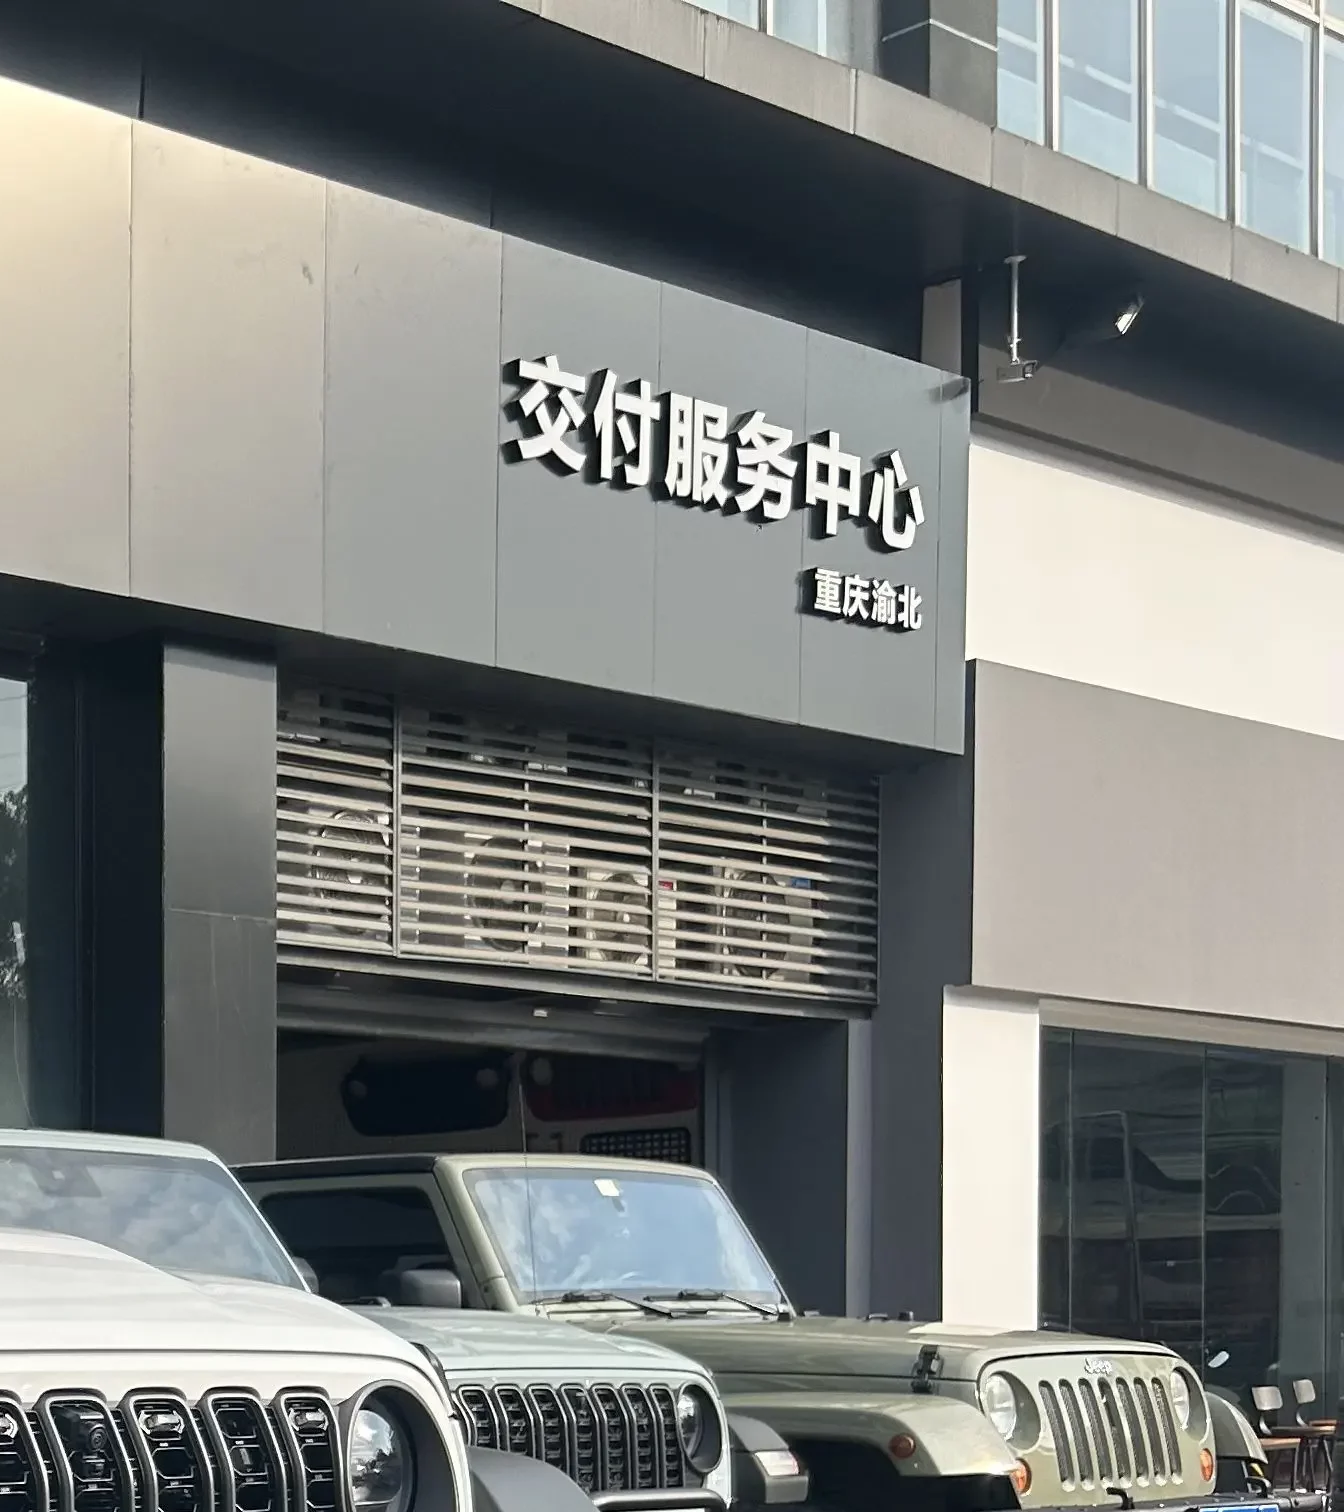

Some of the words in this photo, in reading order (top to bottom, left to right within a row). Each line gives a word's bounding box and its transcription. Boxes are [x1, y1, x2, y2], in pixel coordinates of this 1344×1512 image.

[515, 354, 926, 551] 交付服务中心
[813, 567, 924, 631] 重庆渝北
